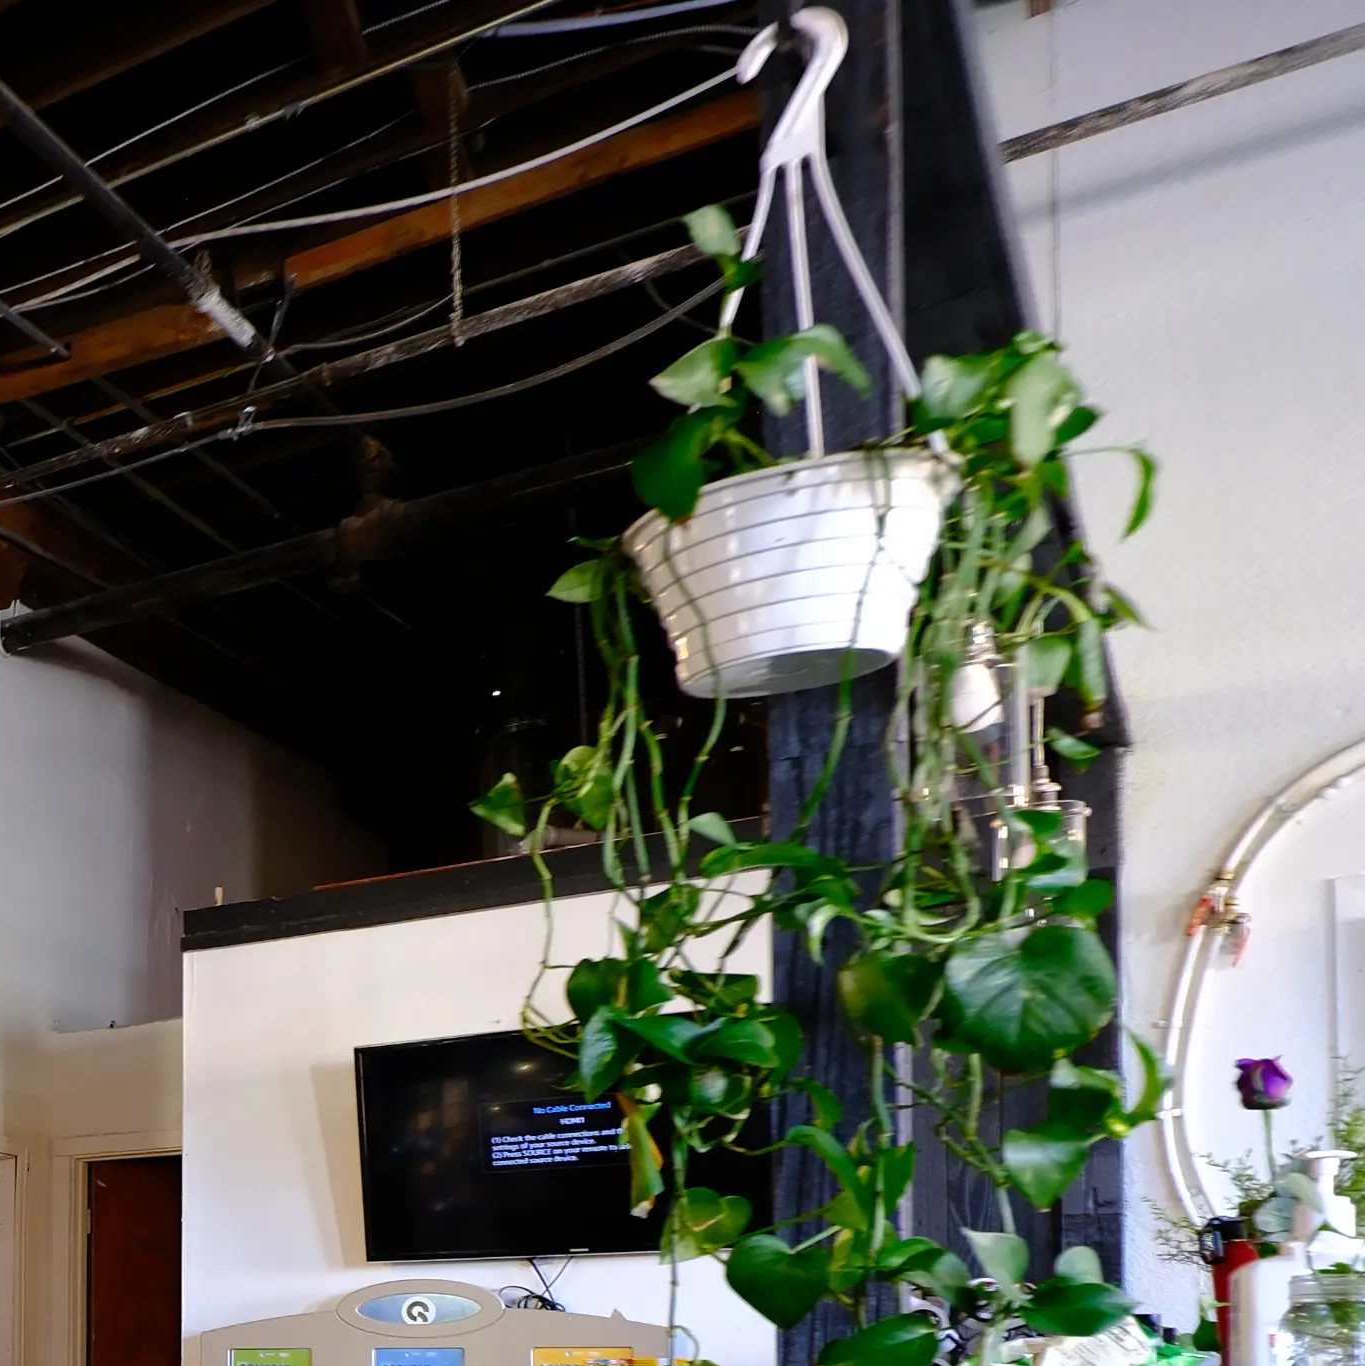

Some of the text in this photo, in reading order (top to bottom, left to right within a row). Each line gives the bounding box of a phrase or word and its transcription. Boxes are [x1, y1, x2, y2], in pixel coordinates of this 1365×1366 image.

[547, 1105, 568, 1113] Cable
[569, 1101, 611, 1111] Connected
[502, 1135, 523, 1143] Check
[537, 1132, 556, 1140] cable
[556, 1130, 600, 1139] connections
[601, 1128, 616, 1136] and
[529, 1142, 546, 1150] your
[522, 1148, 552, 1156] SOURCE
[563, 1147, 581, 1156] your
[492, 1157, 529, 1166] connected
